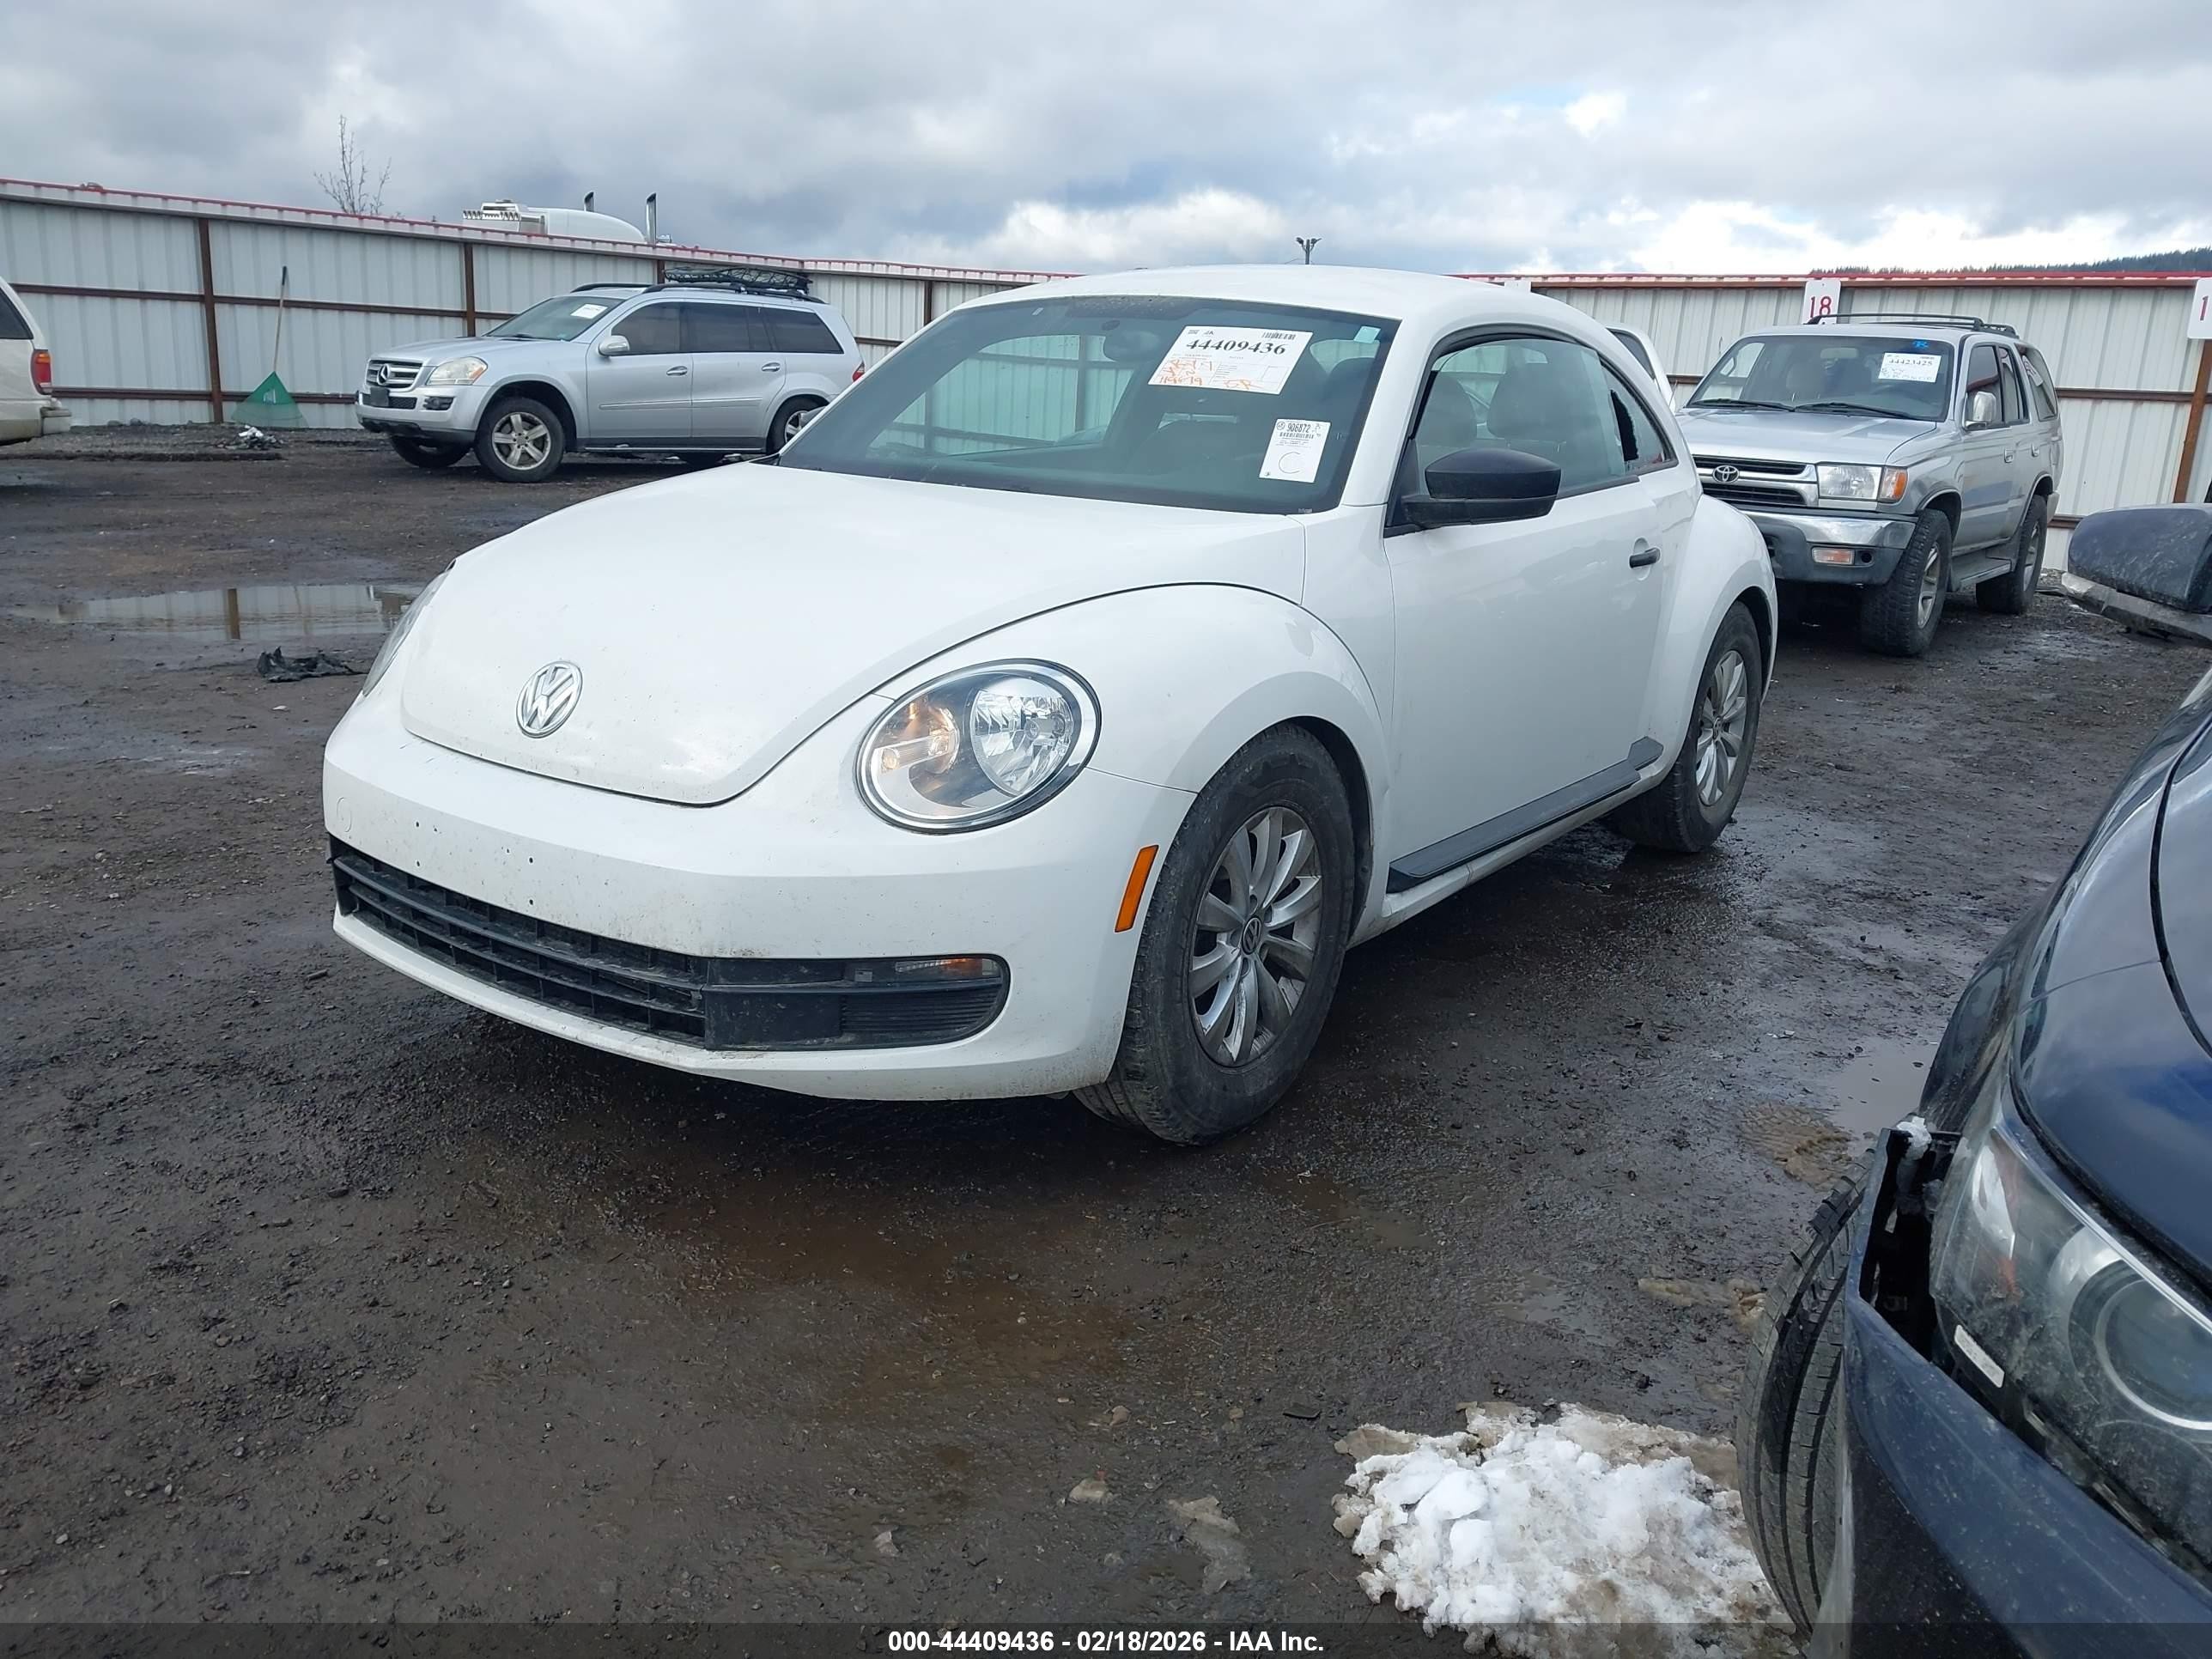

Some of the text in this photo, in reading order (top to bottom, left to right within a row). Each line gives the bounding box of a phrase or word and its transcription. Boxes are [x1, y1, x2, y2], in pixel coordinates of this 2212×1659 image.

[1810, 296, 1832, 319] 18
[1186, 338, 1287, 356] 44409436
[1286, 422, 1311, 434] 906872
[517, 661, 581, 737] VW
